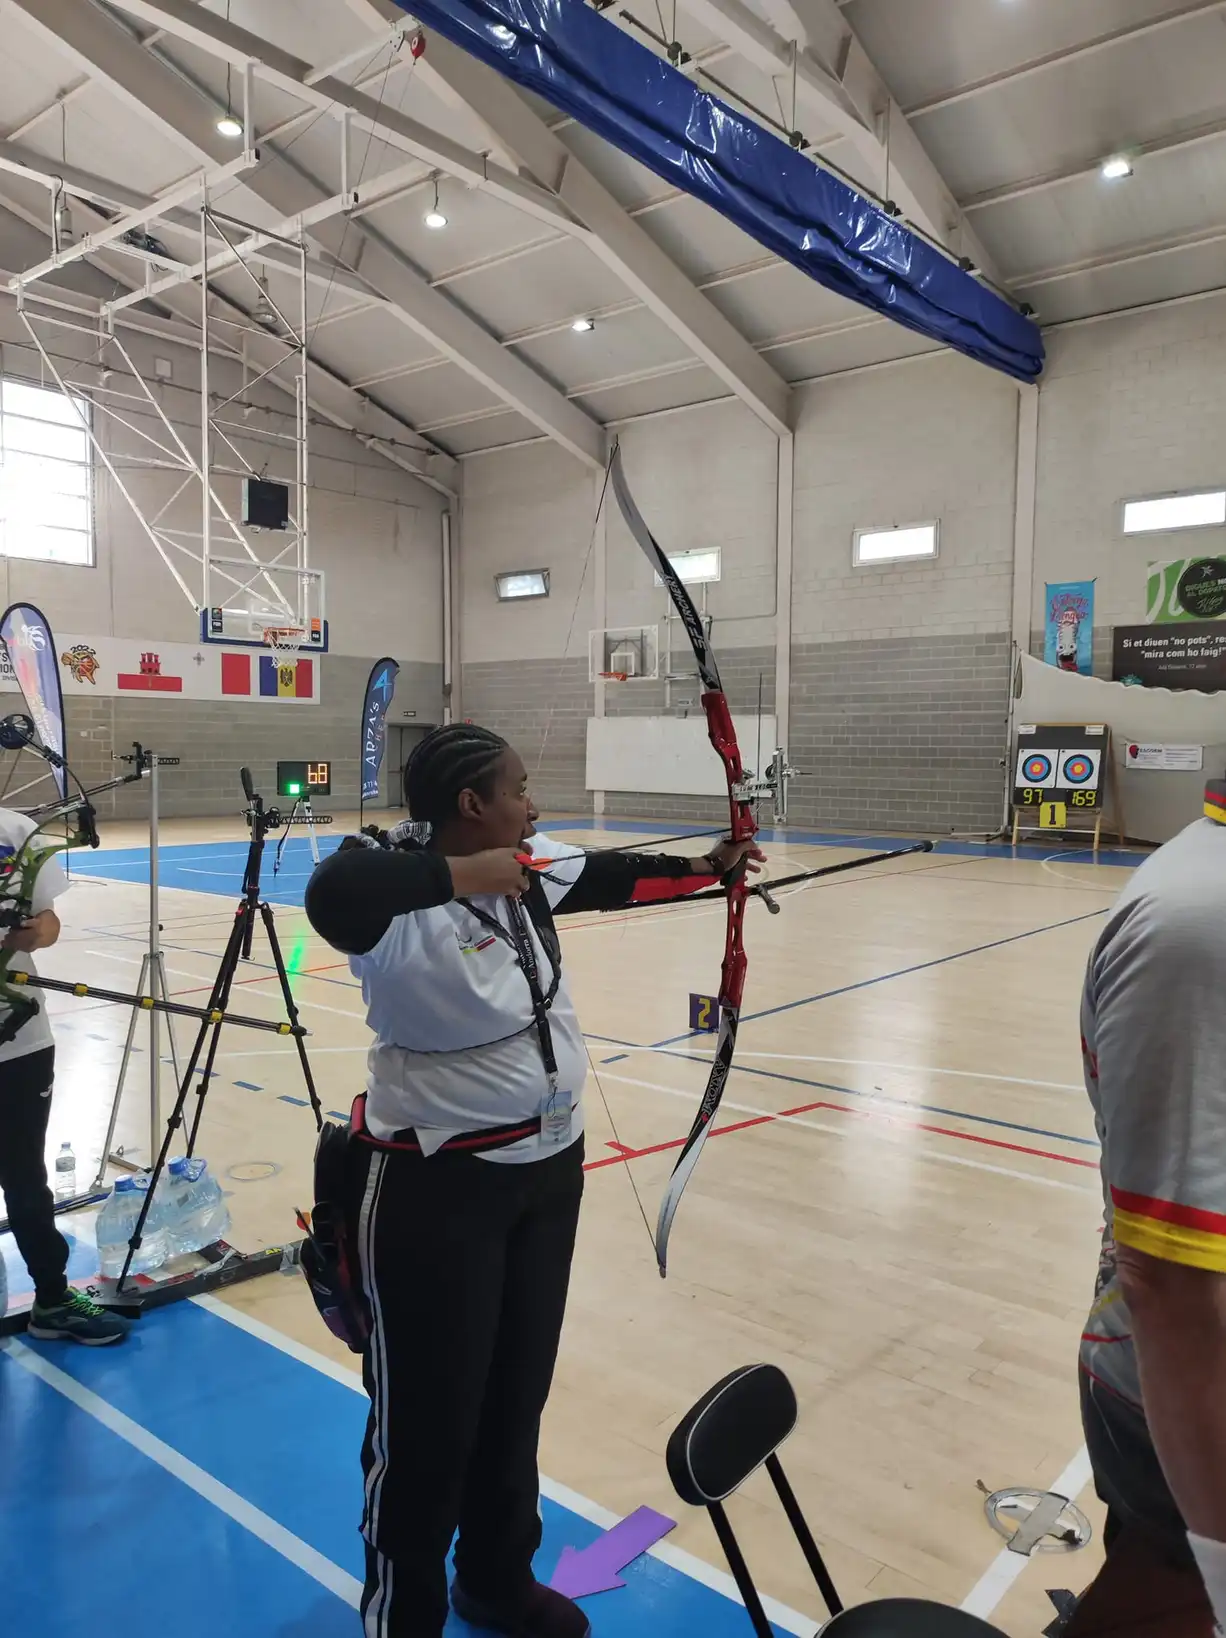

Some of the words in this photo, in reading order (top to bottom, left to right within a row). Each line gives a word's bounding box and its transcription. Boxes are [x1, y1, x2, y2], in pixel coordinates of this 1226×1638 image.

[664, 575, 698, 628] ARCHERY
[1123, 639, 1132, 648] Si
[1134, 639, 1142, 647] et
[1144, 638, 1168, 647] diuen
[1166, 650, 1185, 658] com
[1187, 648, 1199, 657] ho
[307, 763, 328, 785] 68
[1023, 788, 1044, 804] 97
[1072, 790, 1097, 806] 169
[1048, 804, 1057, 825] 1
[697, 997, 711, 1029] 2
